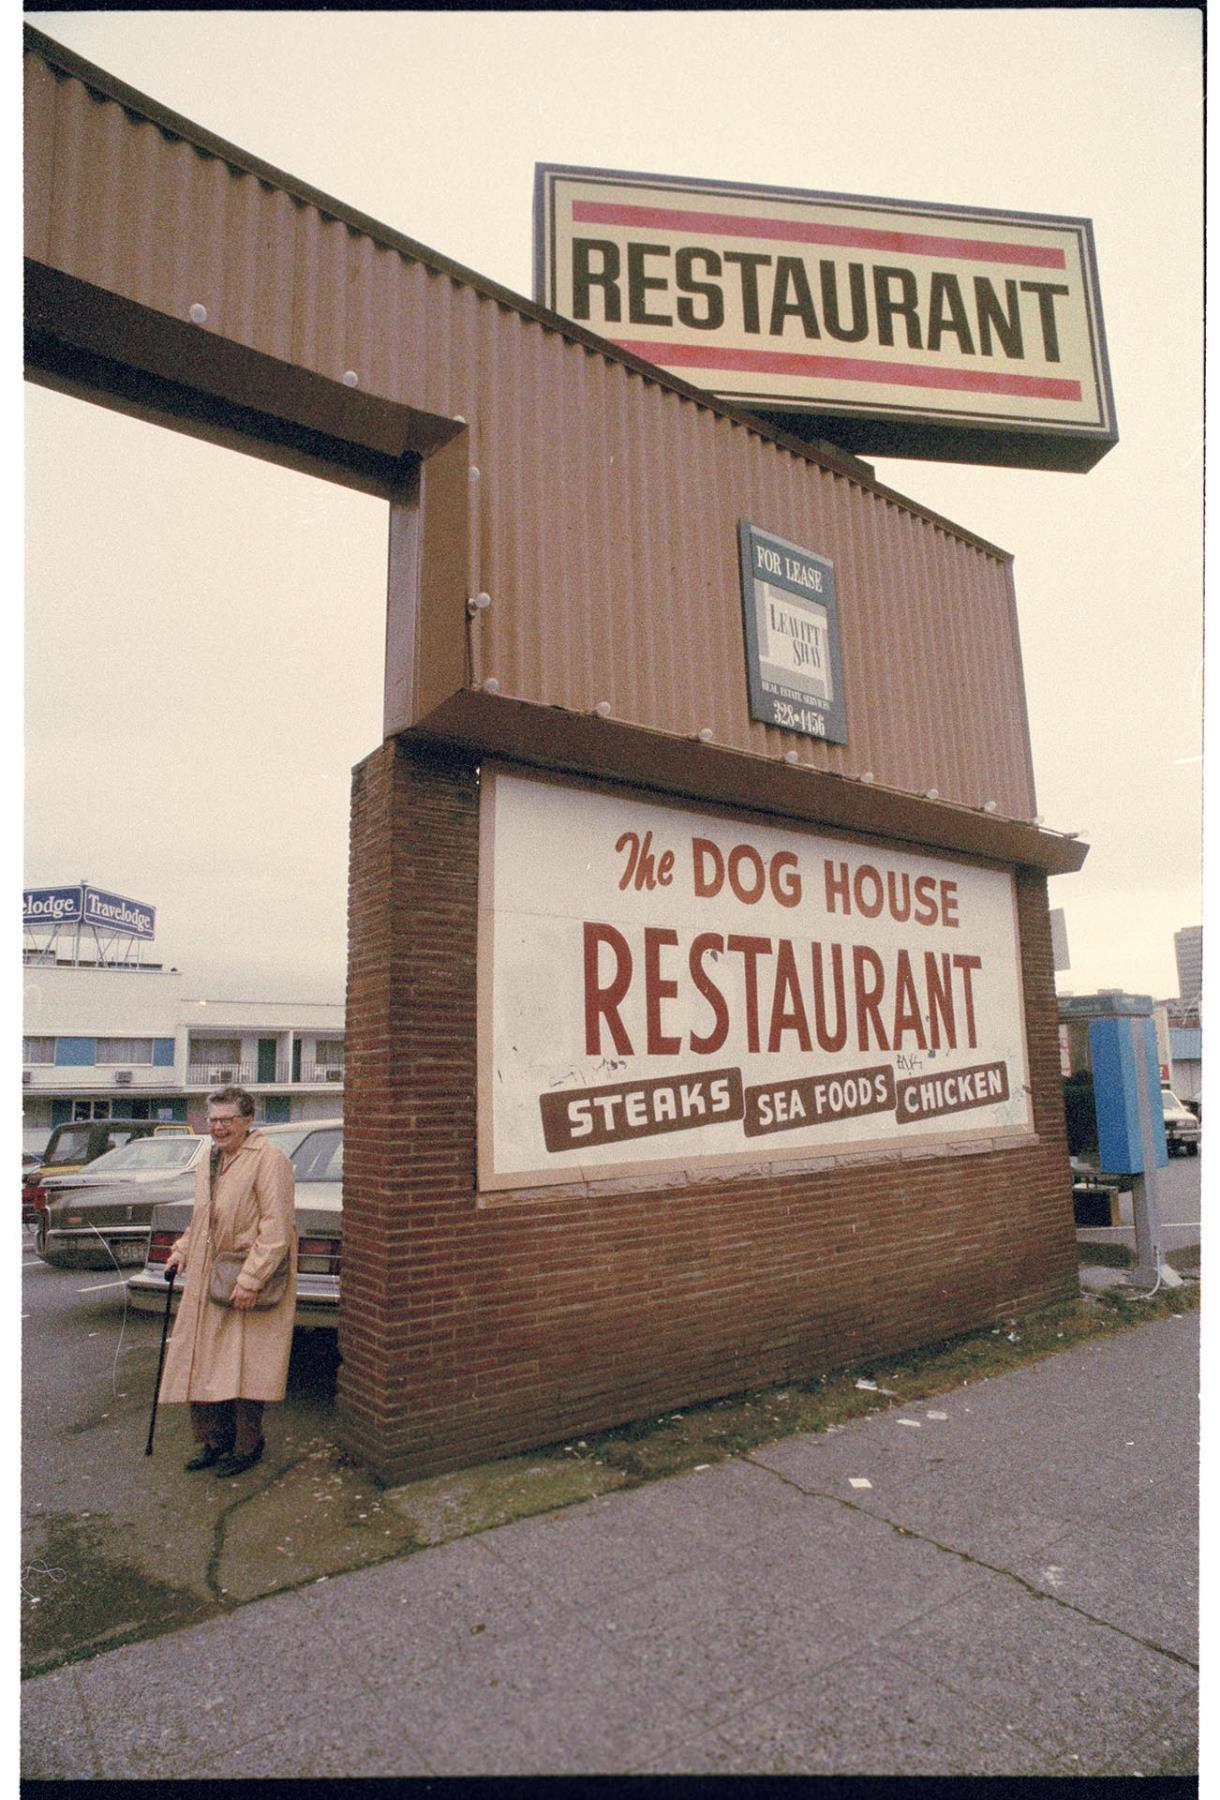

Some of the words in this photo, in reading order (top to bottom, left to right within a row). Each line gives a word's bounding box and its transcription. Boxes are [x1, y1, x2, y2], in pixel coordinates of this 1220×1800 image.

[571, 236, 1070, 363] RESTAURANT
[756, 545, 782, 576] FOR
[785, 557, 823, 593] LEASE
[615, 830, 675, 892] The
[692, 837, 803, 908] DOG
[824, 859, 960, 928] HOUSE
[88, 893, 151, 931] Travelodge
[582, 920, 982, 1056] RESTAURANT
[567, 1077, 732, 1139] STEAKS
[757, 1087, 807, 1127] SEA
[819, 1073, 888, 1118] FOODS
[904, 1069, 1003, 1114] CHICKEN
